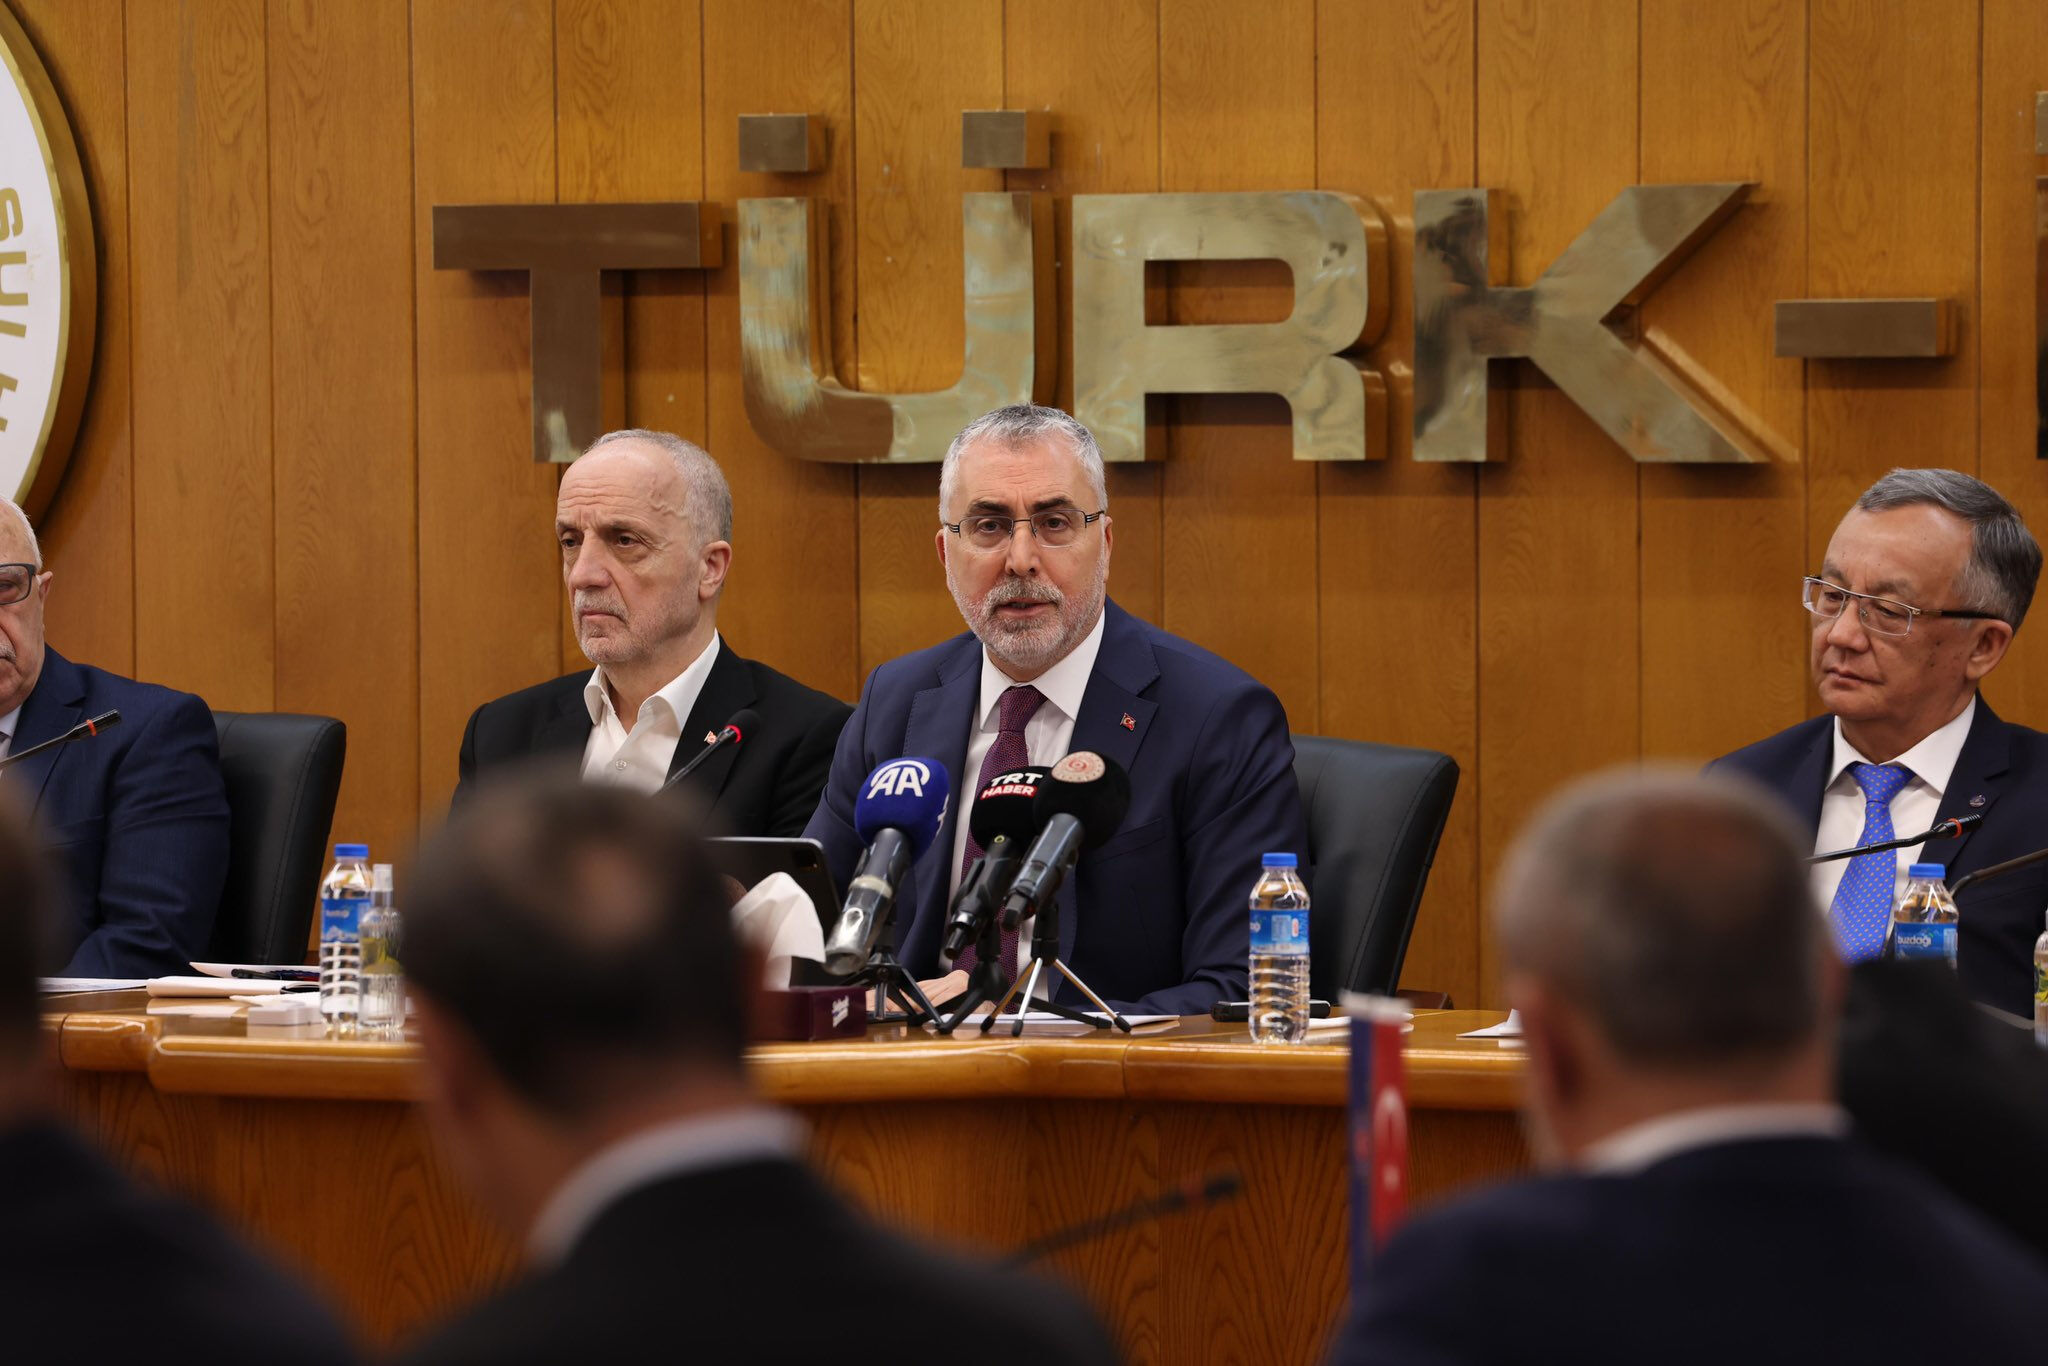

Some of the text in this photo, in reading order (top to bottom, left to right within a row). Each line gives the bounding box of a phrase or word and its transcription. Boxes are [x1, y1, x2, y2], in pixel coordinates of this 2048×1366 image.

[432, 90, 2048, 465] TÜRK-
[866, 765, 924, 800] AA
[980, 784, 1035, 800] HABER
[990, 772, 1044, 788] TRT
